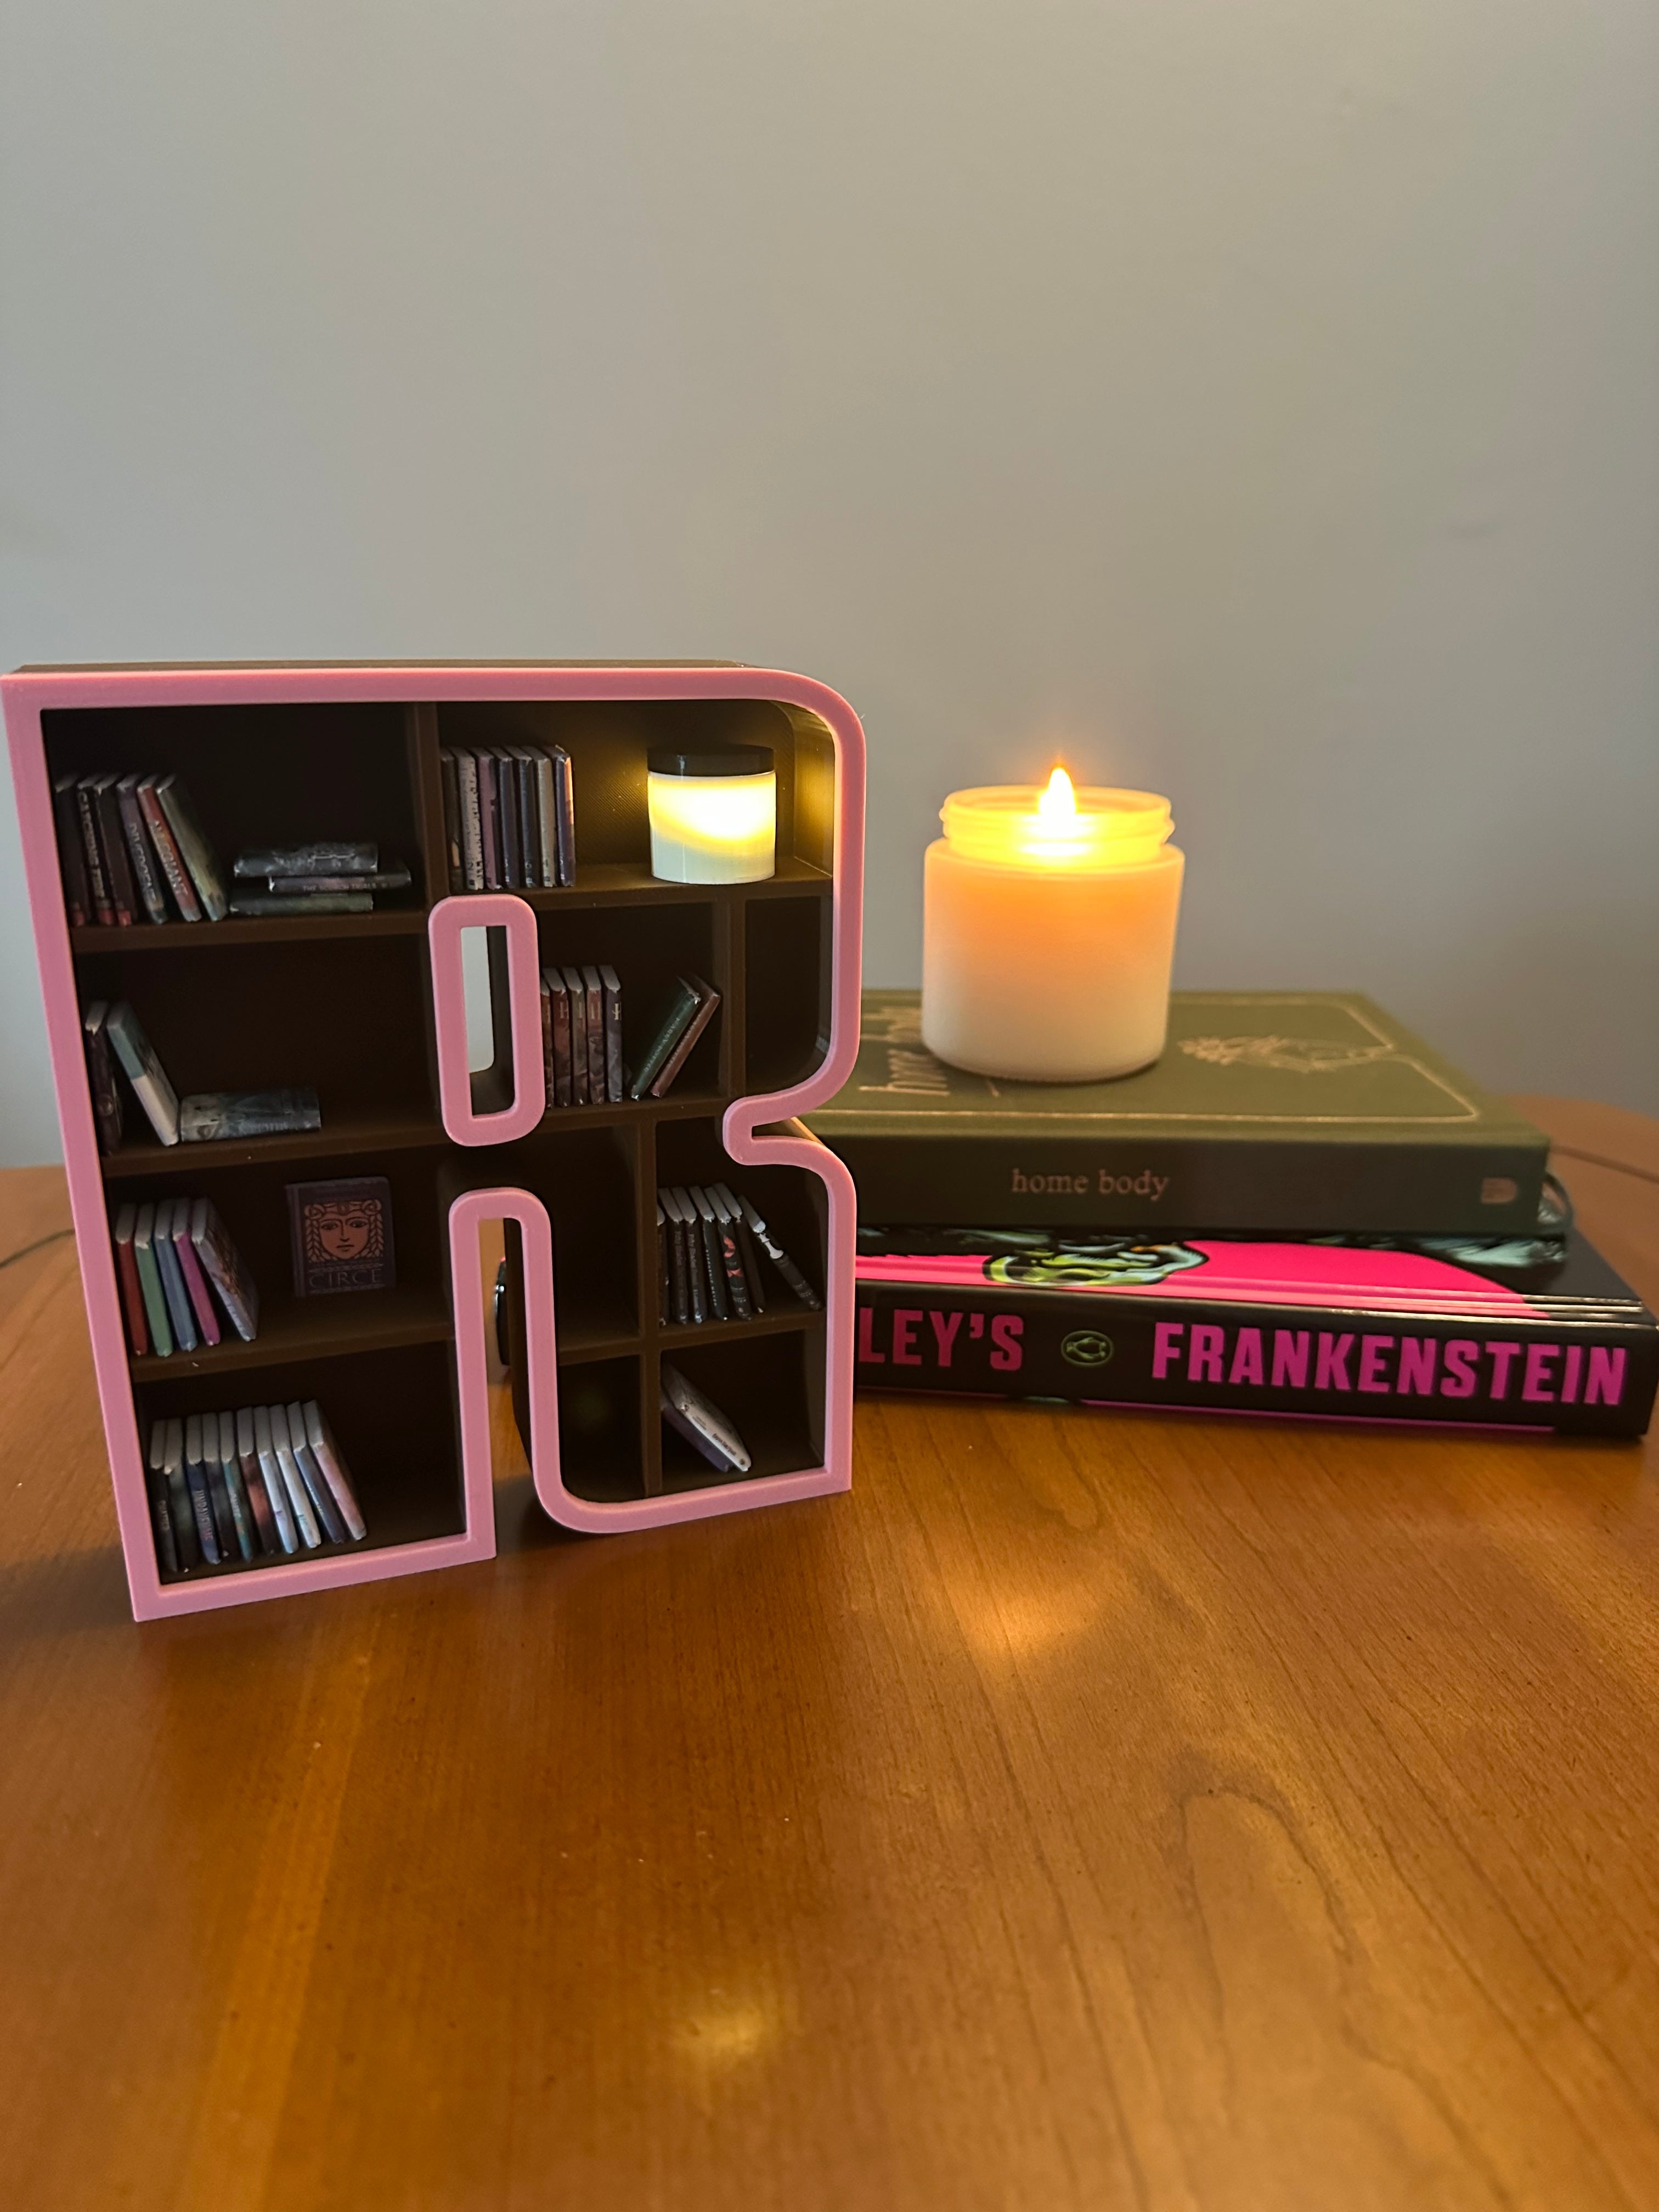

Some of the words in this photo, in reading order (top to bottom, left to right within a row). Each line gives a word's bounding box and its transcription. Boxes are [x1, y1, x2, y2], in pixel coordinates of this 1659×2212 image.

[1012, 1167, 1089, 1194] home
[1098, 1169, 1169, 1201] body
[308, 1267, 382, 1288] CIRCE
[859, 1307, 1024, 1371] LEY'S
[1151, 1322, 1627, 1406] FRANKENSTEIN
